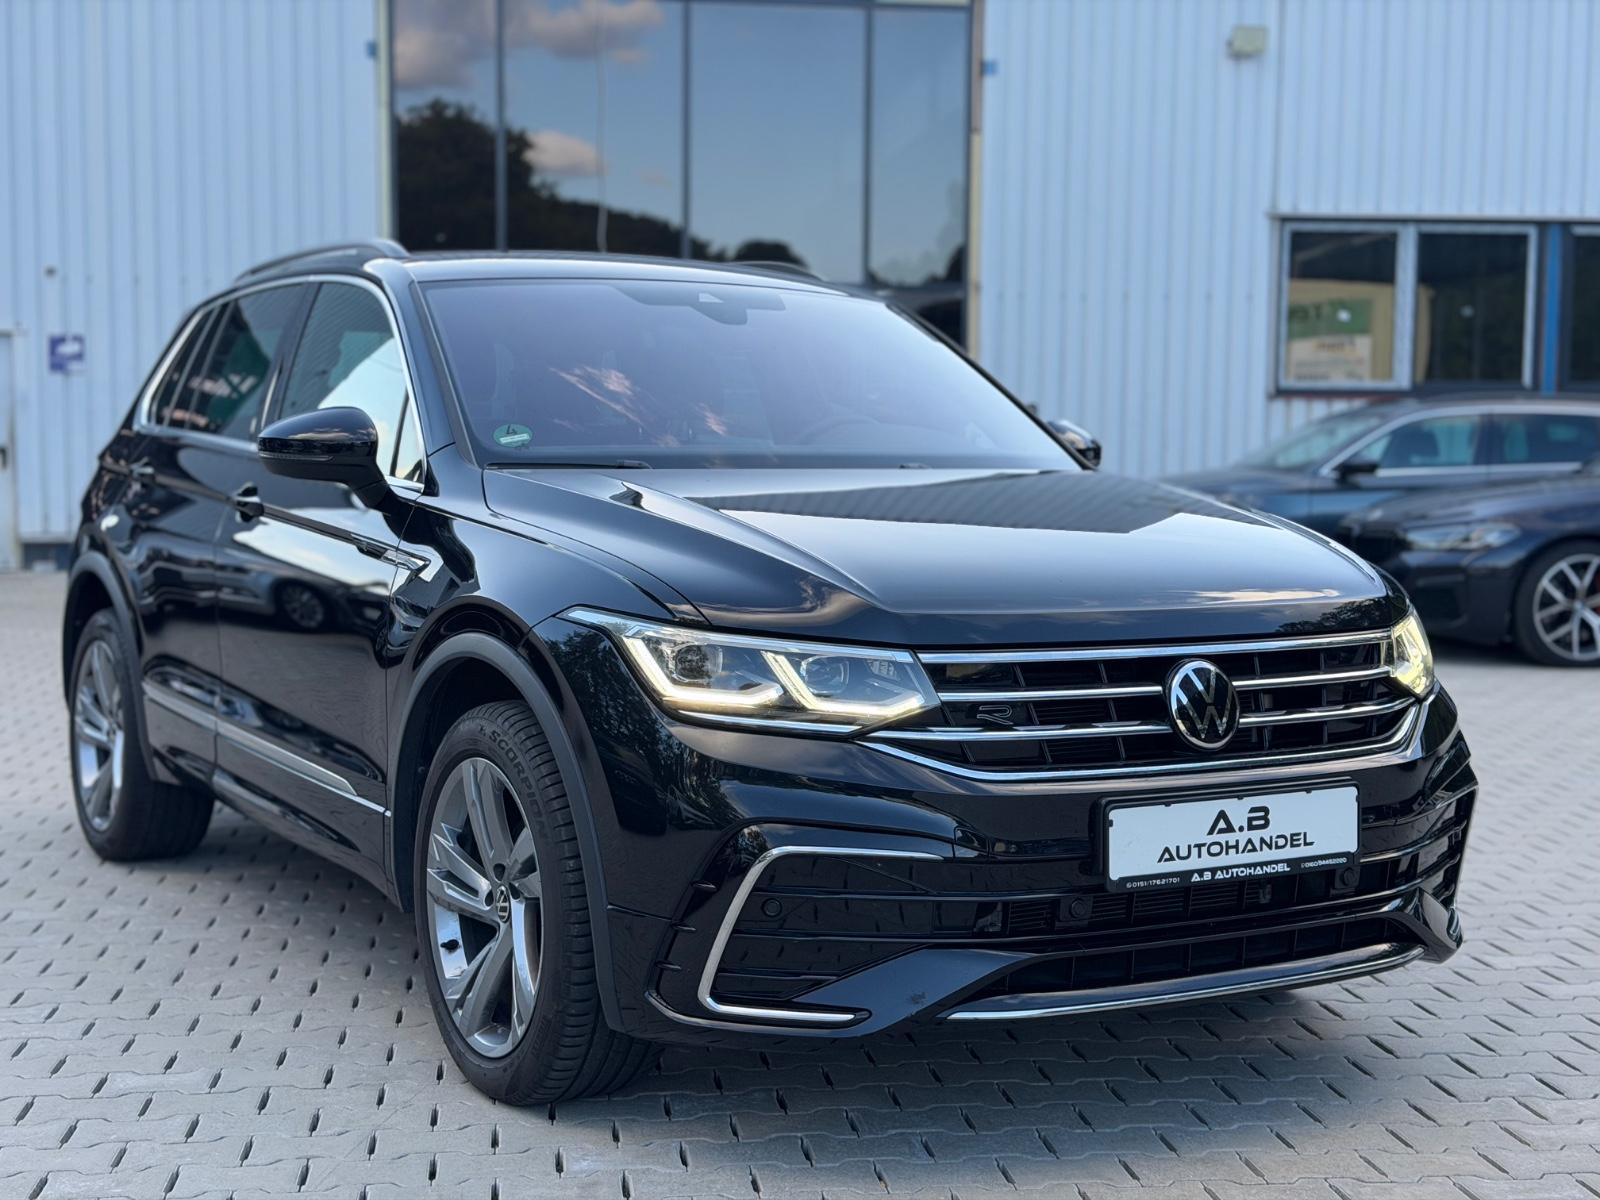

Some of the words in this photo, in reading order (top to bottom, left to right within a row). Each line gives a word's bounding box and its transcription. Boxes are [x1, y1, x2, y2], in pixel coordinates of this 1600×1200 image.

[1207, 806, 1270, 836] A.B
[1157, 832, 1315, 863] AUTOHANDEL
[1191, 871, 1212, 882] A.B
[1214, 863, 1291, 880] AUTOHANDEL
